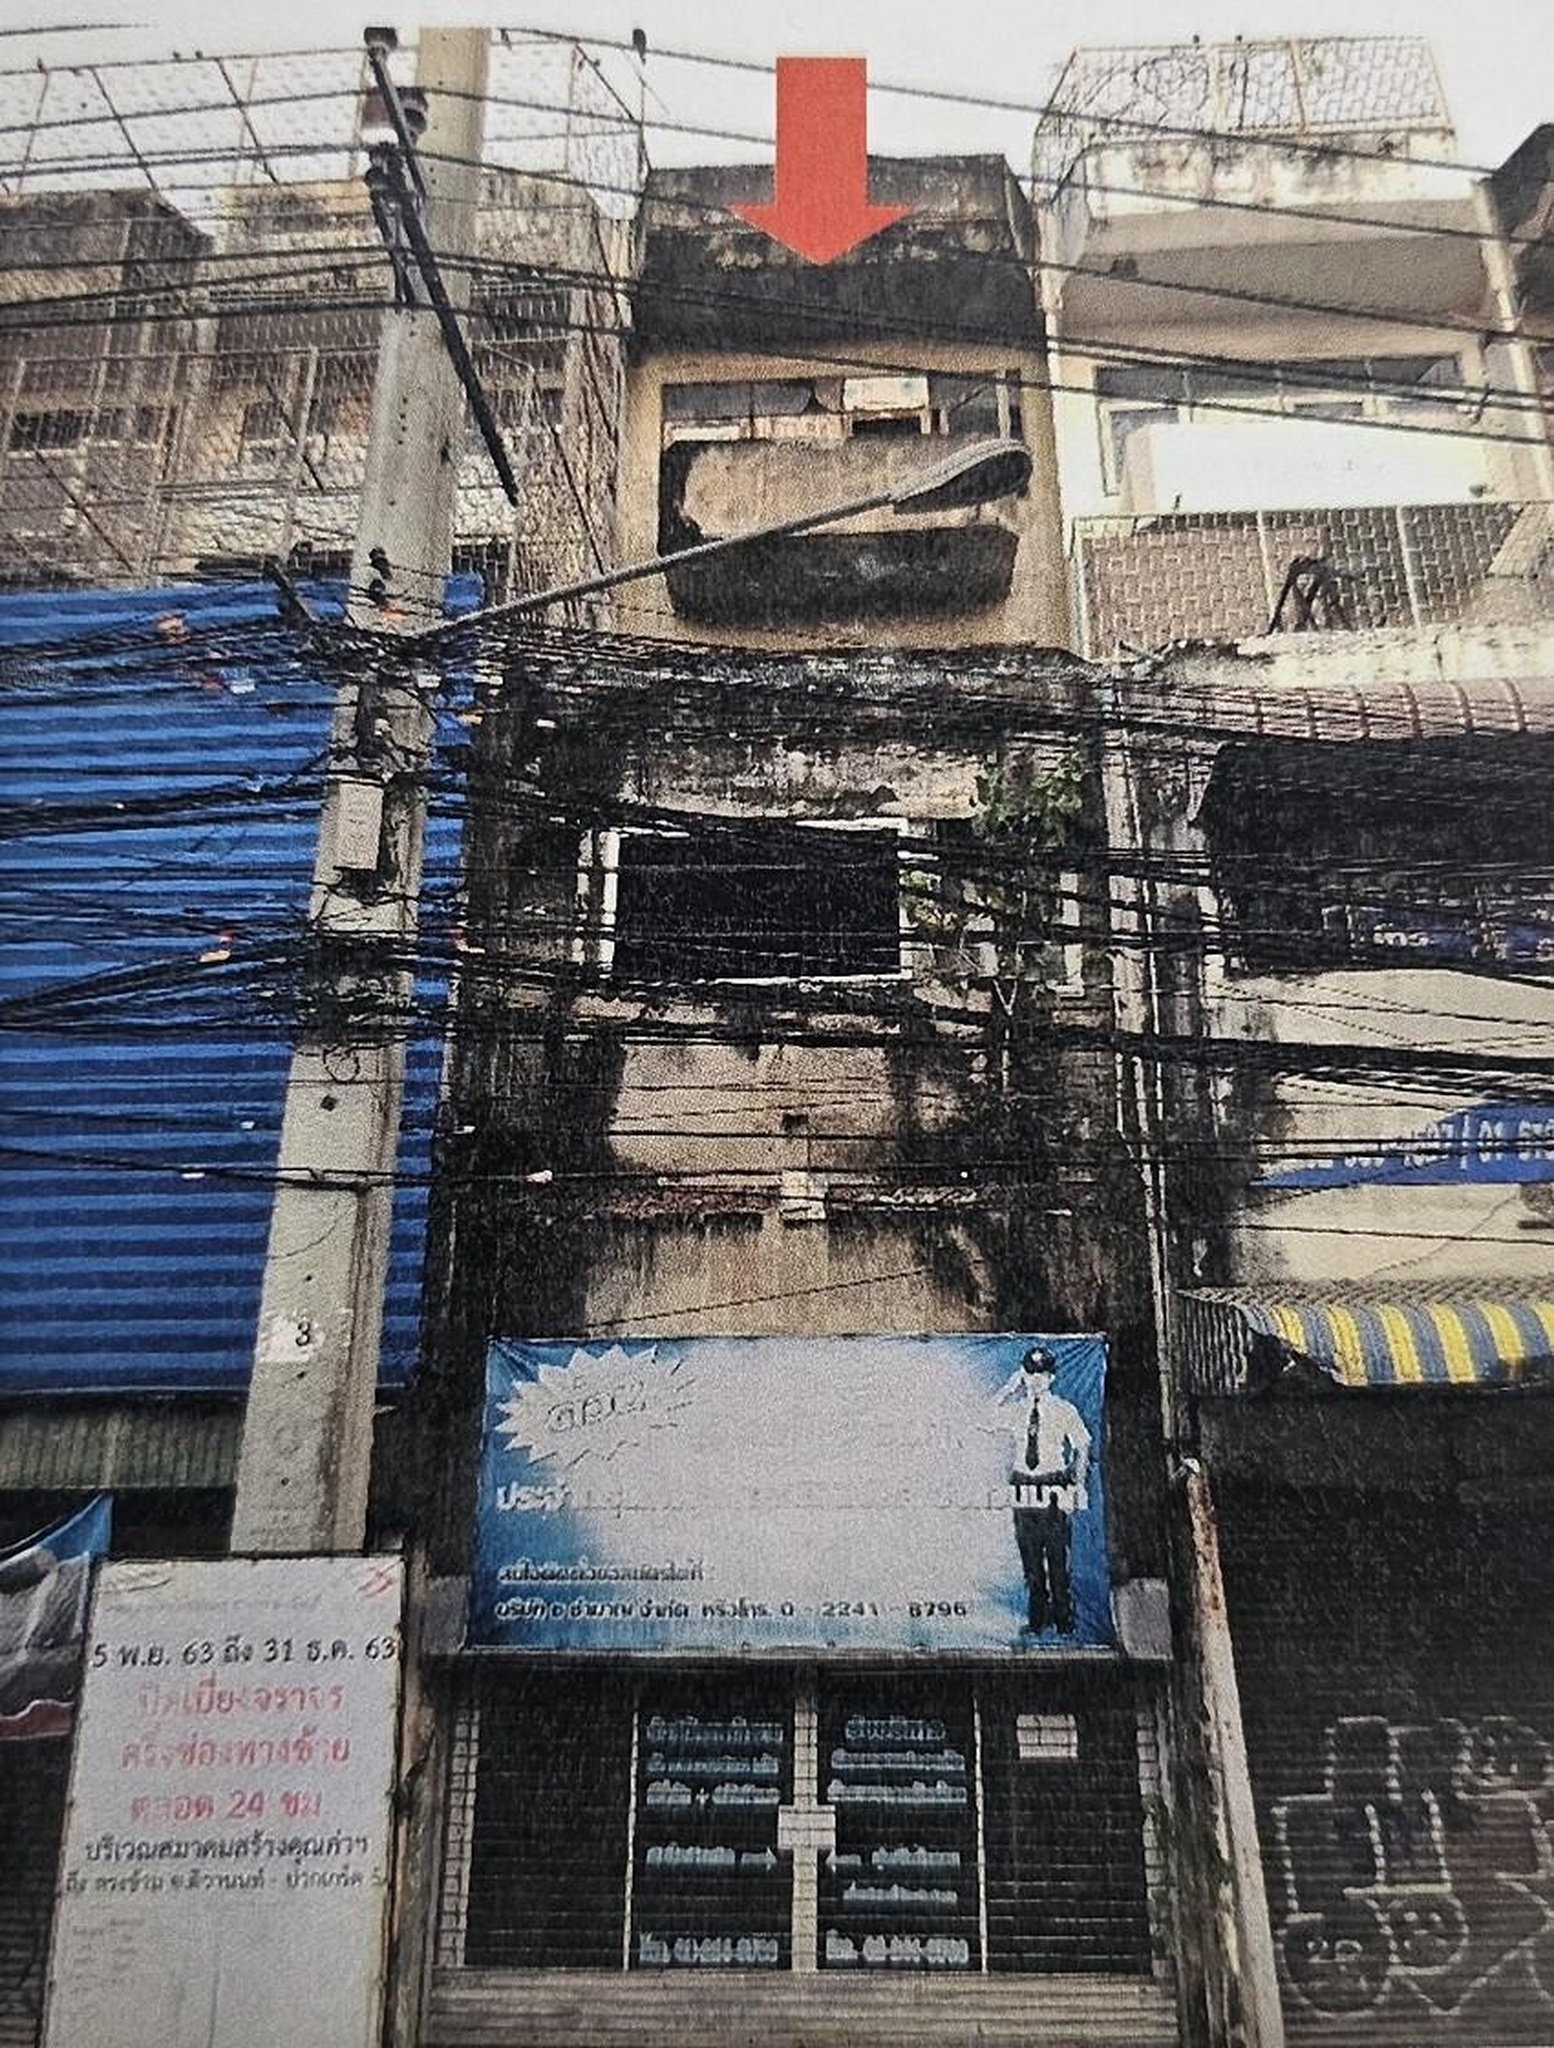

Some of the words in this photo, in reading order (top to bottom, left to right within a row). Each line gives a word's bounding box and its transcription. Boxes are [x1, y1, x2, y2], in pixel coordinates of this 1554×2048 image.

[640, 1599, 690, 1618] จำกัด
[780, 1601, 794, 1616] 0
[93, 1643, 107, 1668] 5
[182, 1640, 214, 1665] 63
[222, 1634, 253, 1663] ถึง
[263, 1638, 295, 1662] 31
[306, 1638, 354, 1662] ธ.ค.
[365, 1636, 396, 1661] 63
[132, 1794, 214, 1822] ตอด
[227, 1789, 265, 1819] 24
